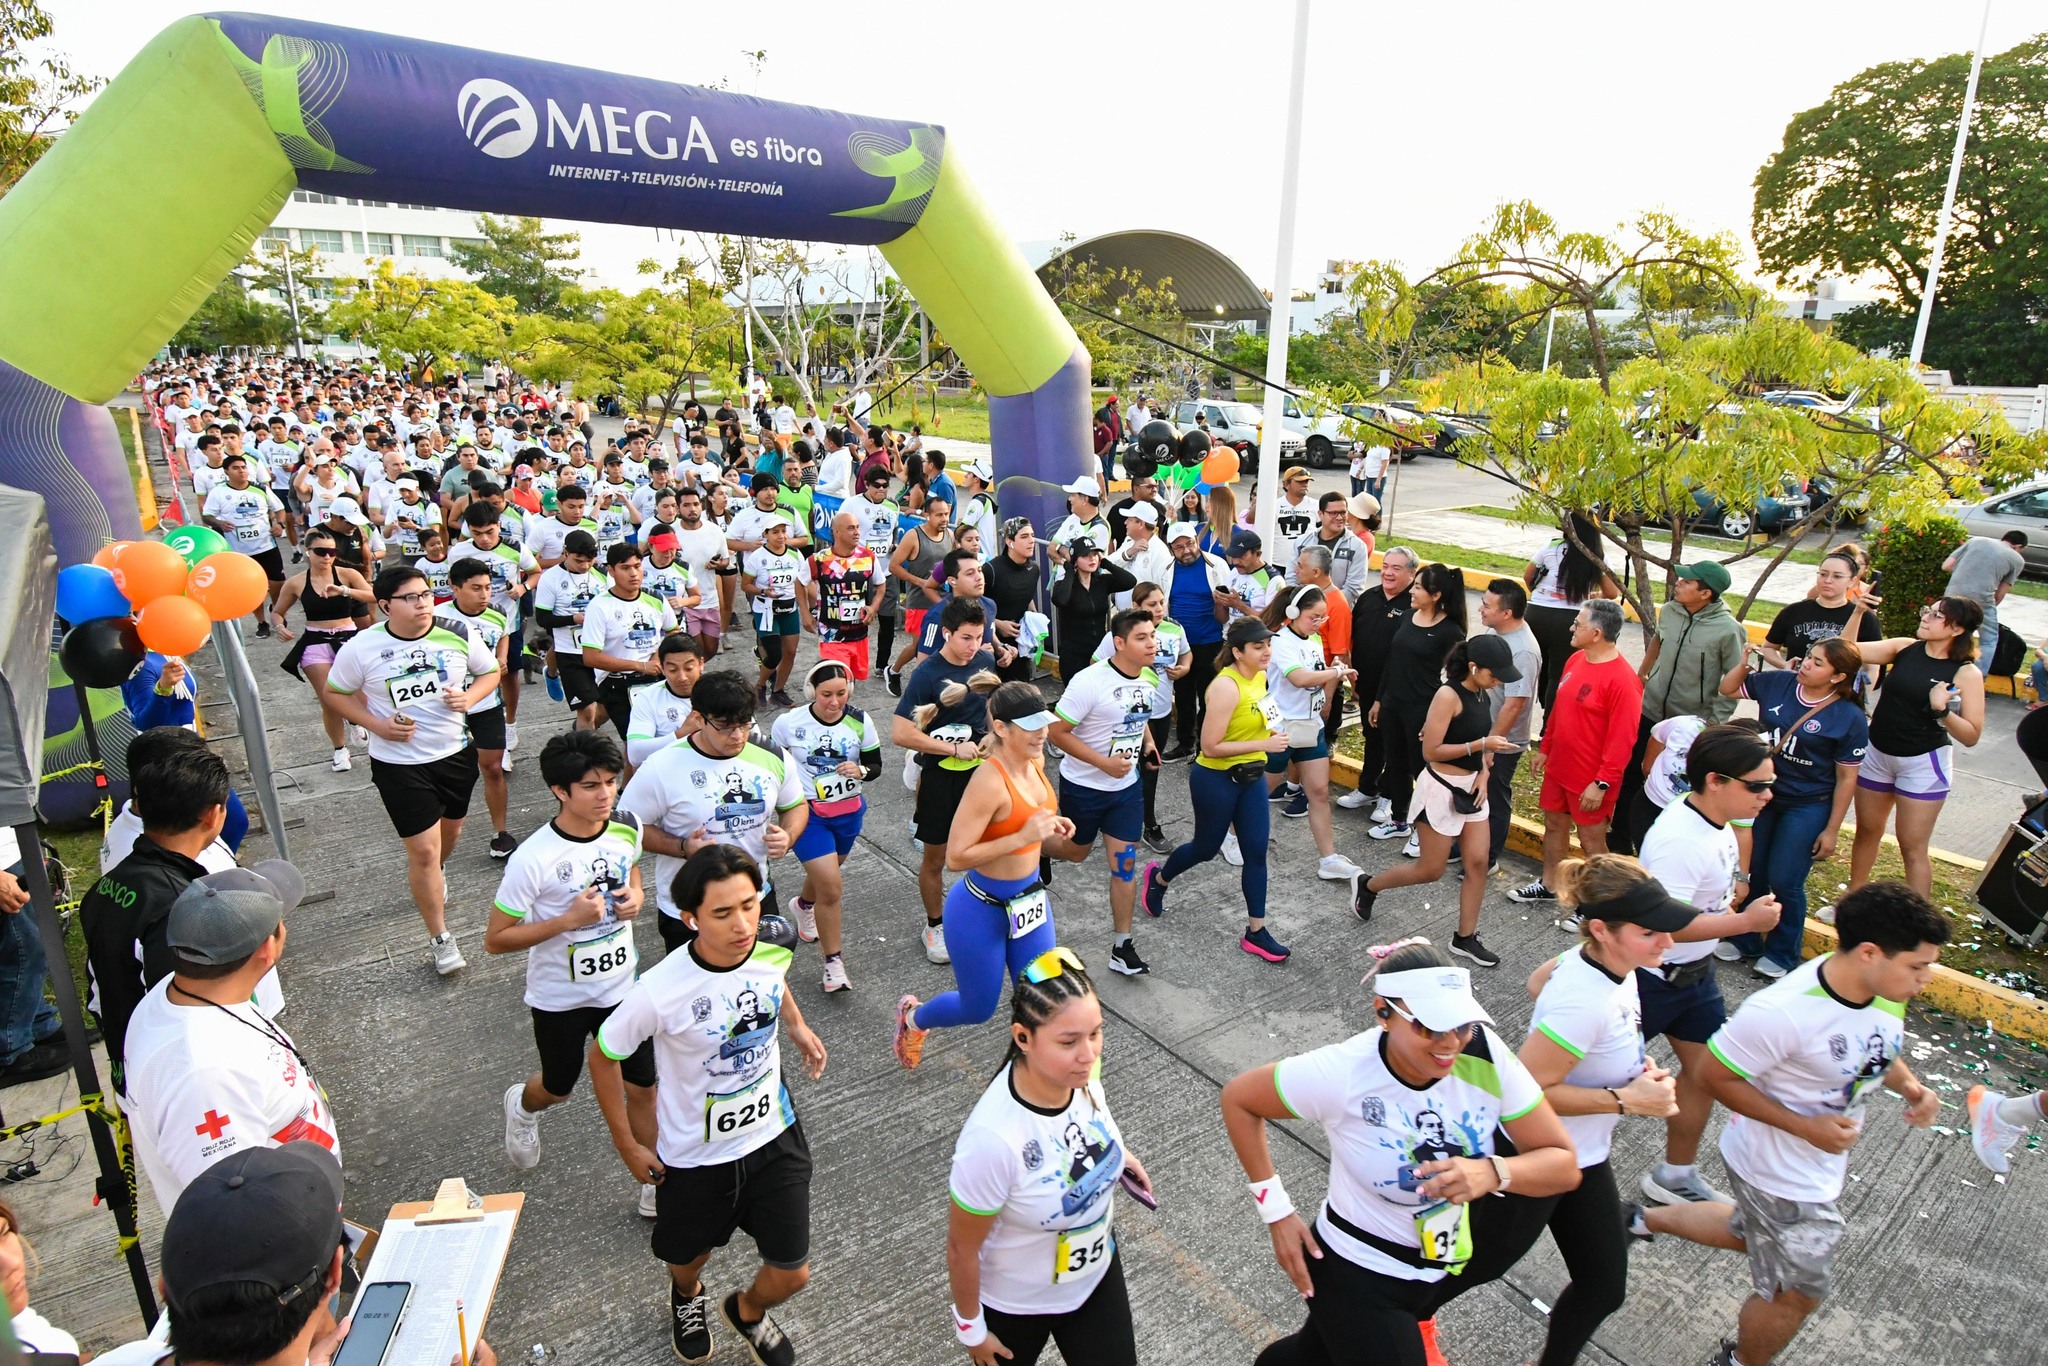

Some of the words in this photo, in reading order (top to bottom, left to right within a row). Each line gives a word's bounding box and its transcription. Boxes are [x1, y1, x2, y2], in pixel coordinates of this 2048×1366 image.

[546, 98, 719, 164] MEGA
[730, 137, 758, 158] es
[764, 136, 823, 167] fibra
[240, 530, 260, 539] 528
[869, 546, 887, 554] 202
[772, 574, 792, 584] 279
[825, 580, 868, 595] VILLA
[843, 607, 859, 617] 27
[396, 681, 438, 703] 264
[823, 778, 856, 799] 216
[1016, 902, 1043, 930] 028
[580, 946, 627, 976] 388
[717, 1093, 770, 1133] 628
[201, 1142, 218, 1153] CRUZ
[202, 1141, 237, 1158] MEXICANA
[1068, 1234, 1104, 1272] 35
